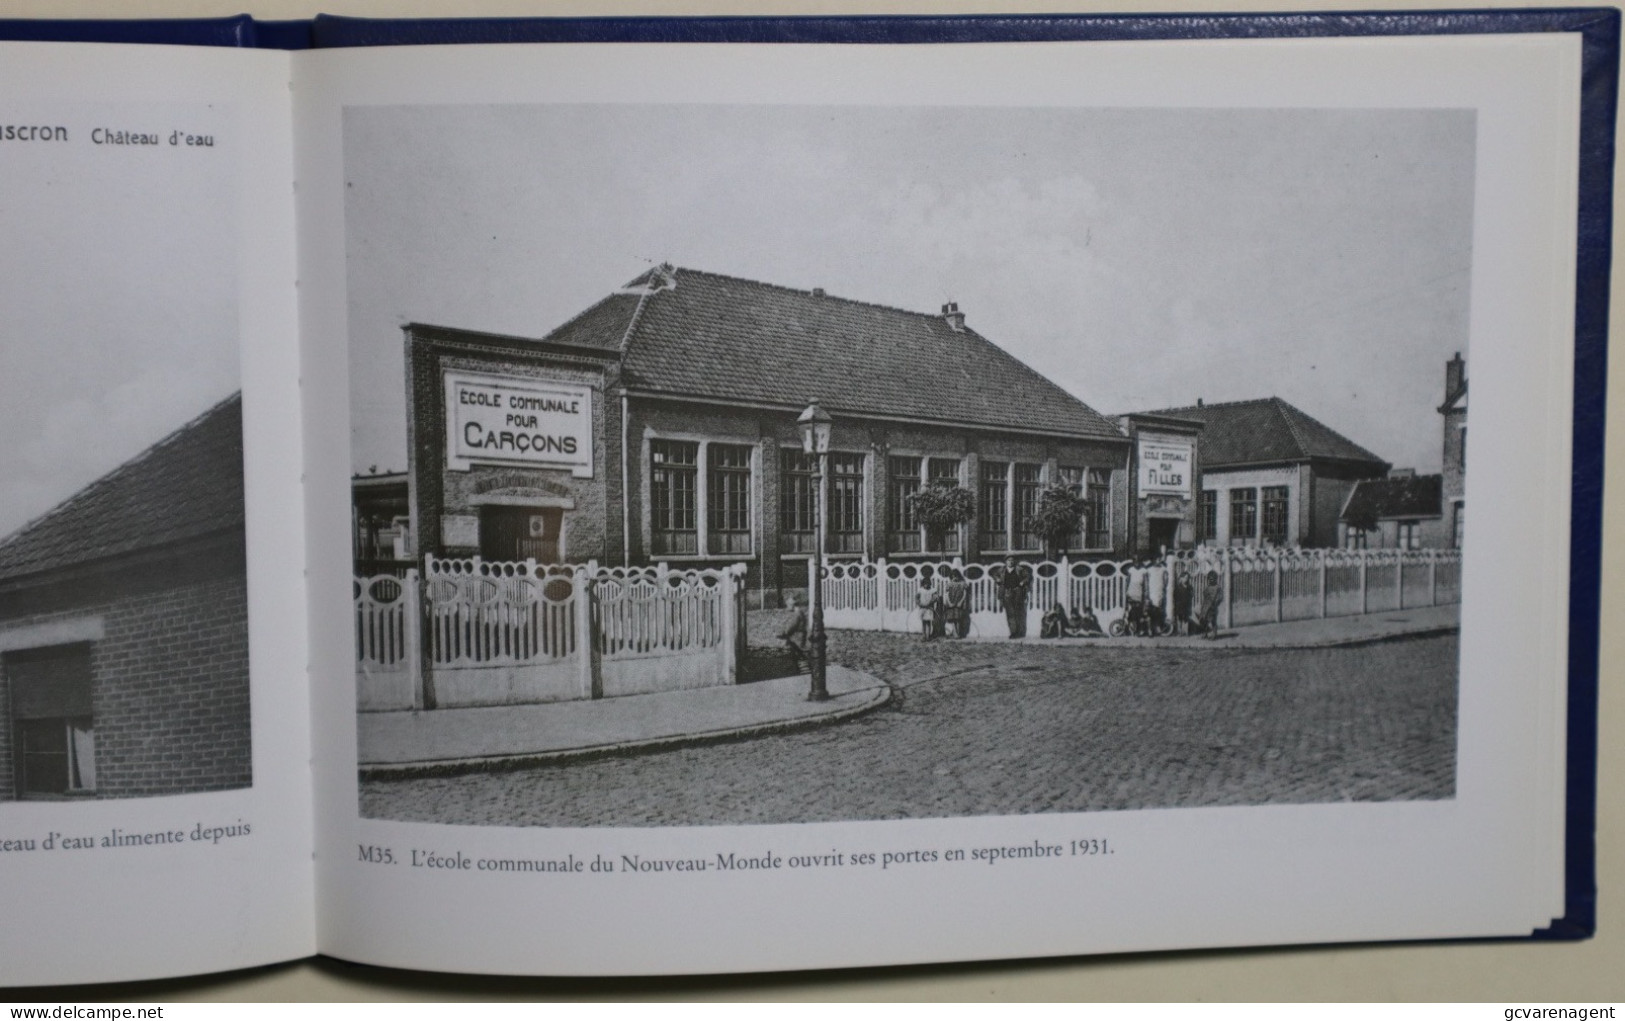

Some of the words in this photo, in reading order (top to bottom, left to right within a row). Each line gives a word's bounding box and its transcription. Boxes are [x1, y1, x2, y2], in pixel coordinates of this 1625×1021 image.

[0, 126, 68, 141] scron
[91, 128, 159, 145] Château
[169, 130, 214, 147] d'eau
[460, 388, 501, 409] ÉCOLE
[509, 396, 579, 414] COMMUNALE
[506, 414, 537, 428] POUR
[464, 421, 577, 454] GARÇONS
[1149, 469, 1182, 486] FILLES
[42, 831, 94, 850] d'eau
[101, 829, 184, 848] alimente
[190, 819, 251, 844] depuis
[358, 844, 398, 865] M35.
[411, 850, 471, 870] L'école
[477, 854, 584, 872] communale
[590, 854, 614, 873] du
[621, 851, 782, 873] Nouveau-Monde
[788, 851, 844, 868] ouvrit
[850, 852, 876, 865] ses
[882, 848, 938, 869] portes
[944, 848, 965, 862] en
[971, 840, 1063, 864] septembre
[1070, 839, 1115, 856] 1931.
